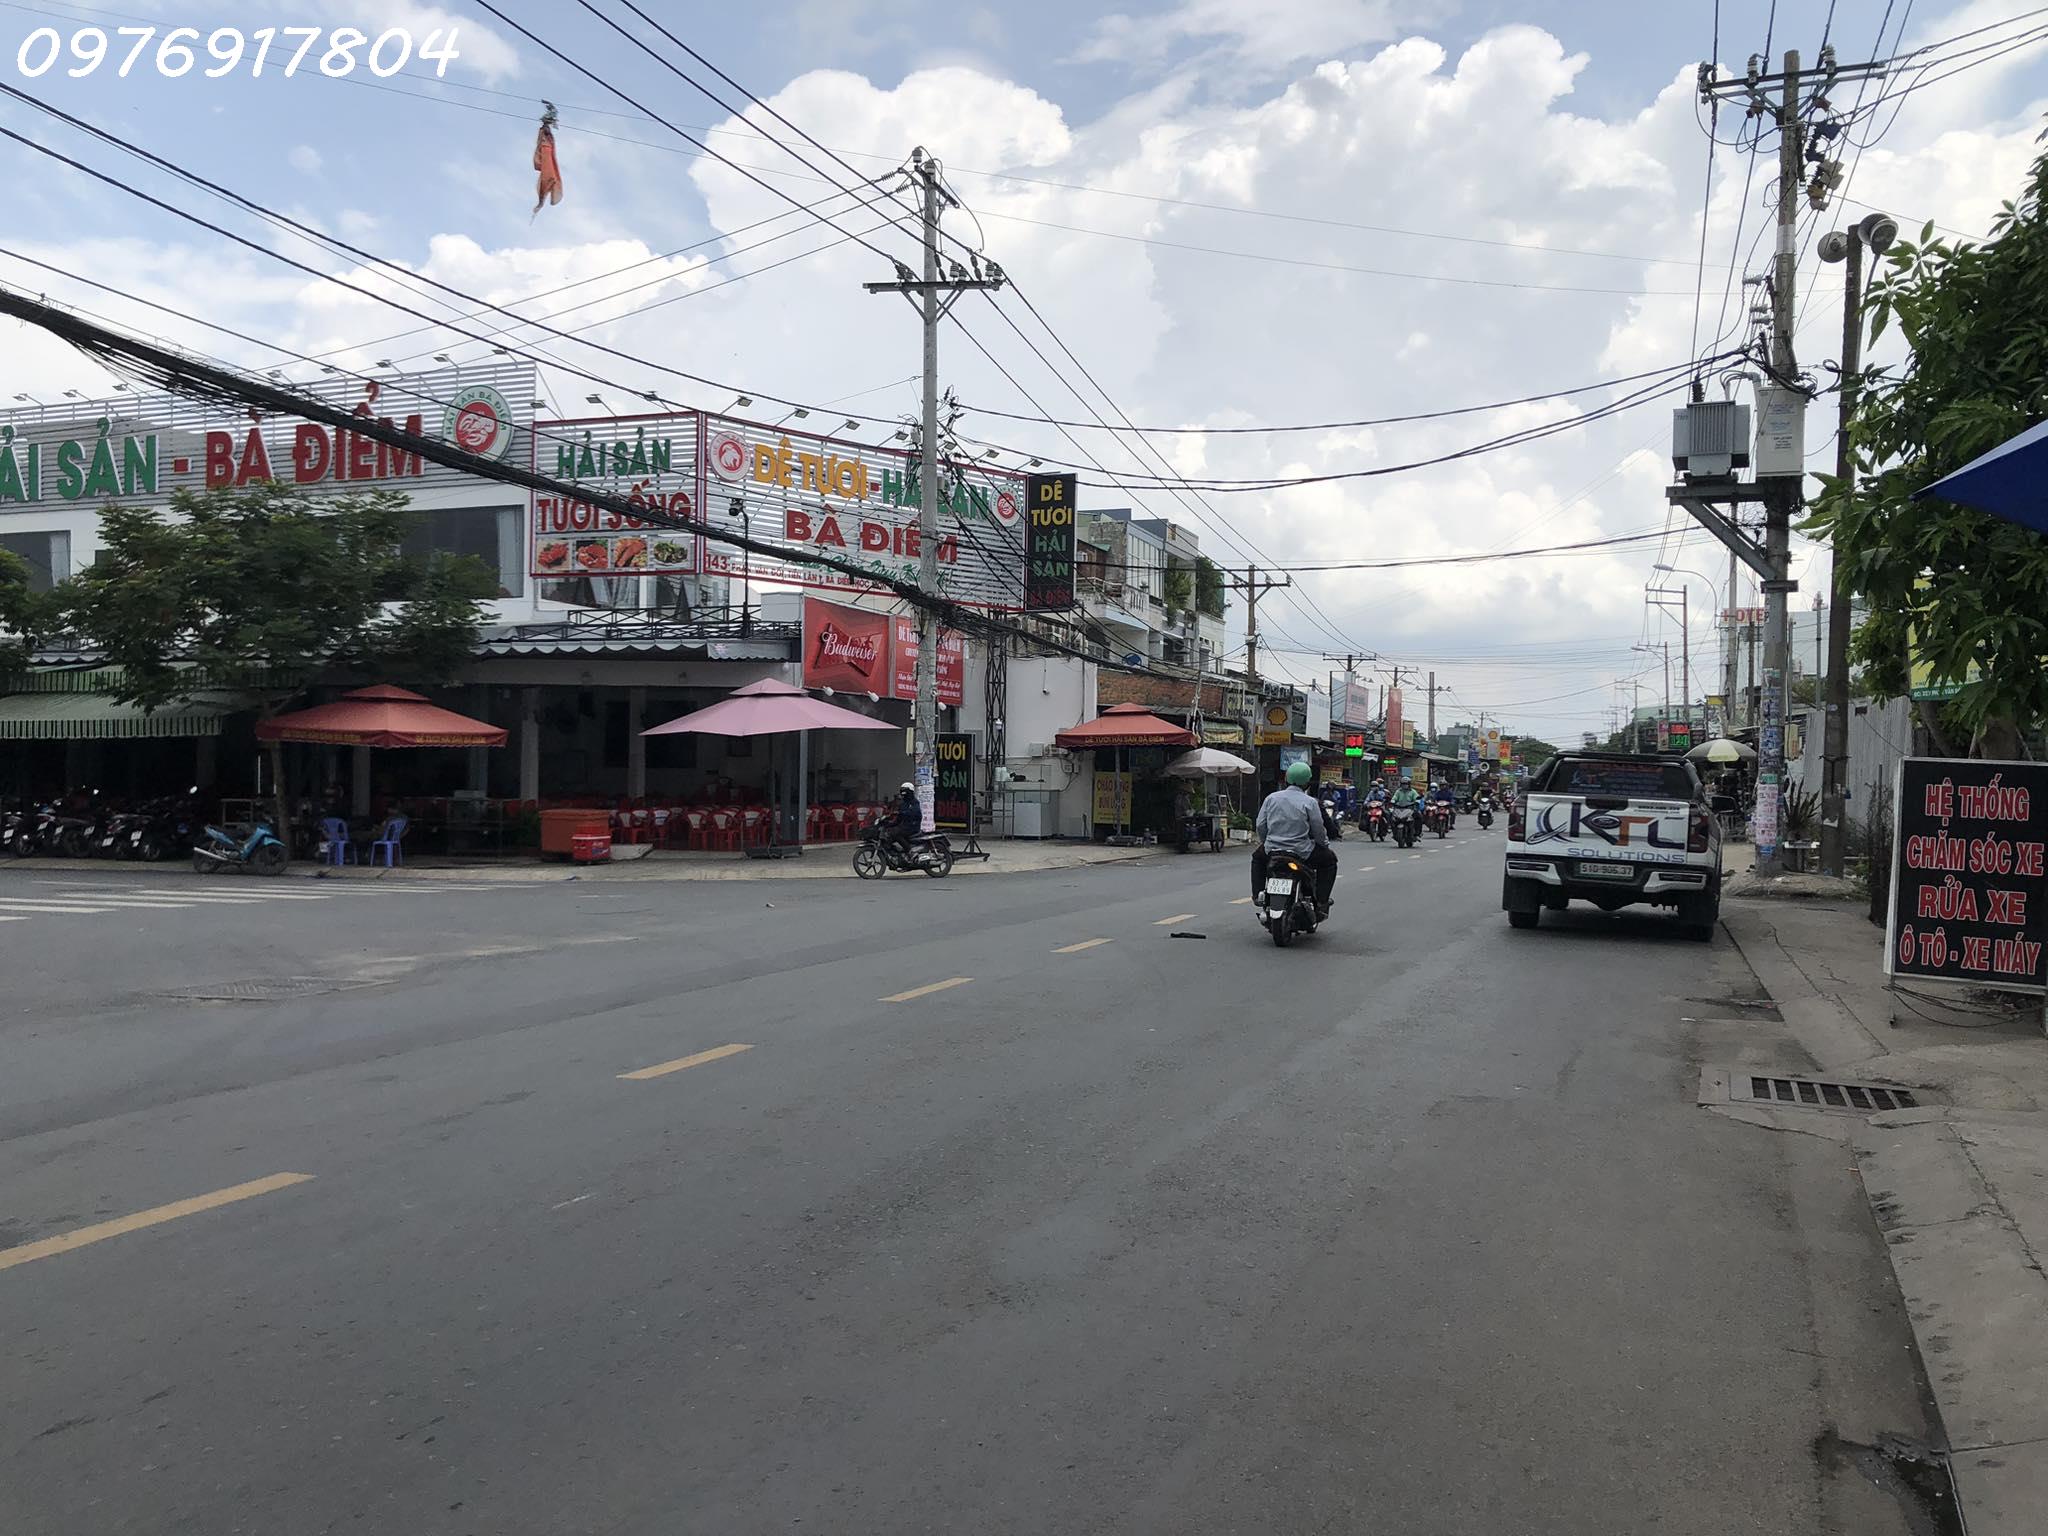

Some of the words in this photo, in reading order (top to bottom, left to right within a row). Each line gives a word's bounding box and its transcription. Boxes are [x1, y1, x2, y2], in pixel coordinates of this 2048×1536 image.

[56, 416, 159, 500] SẢN
[206, 407, 275, 490] BÀ
[557, 430, 607, 479] HẢI
[613, 426, 673, 476] SẢN
[754, 436, 794, 488] DÊ
[799, 453, 868, 499] TƯƠI
[1040, 479, 1063, 502] DÊ
[786, 503, 847, 547] BÀ
[1031, 505, 1072, 526] TƯƠI
[1035, 529, 1067, 553] HẢI
[1032, 554, 1069, 578] SẢN
[821, 631, 878, 661] Budweiser
[938, 741, 967, 761] TƯƠI
[942, 765, 968, 788] SẢN
[1925, 777, 1954, 827] HỆ
[1958, 773, 2030, 822] THỐNG
[1569, 848, 1685, 864] SOLUTIONS
[1906, 829, 1967, 871] CHĂM
[1969, 831, 2012, 875] SÓC
[2015, 842, 2045, 877] XE
[1917, 874, 1979, 922] RỬA
[1984, 889, 2027, 926] XE
[1899, 924, 1916, 966] Ô
[1919, 926, 1947, 968] TÔ
[1961, 936, 1991, 971] XE
[1994, 932, 2042, 976] MÁY
